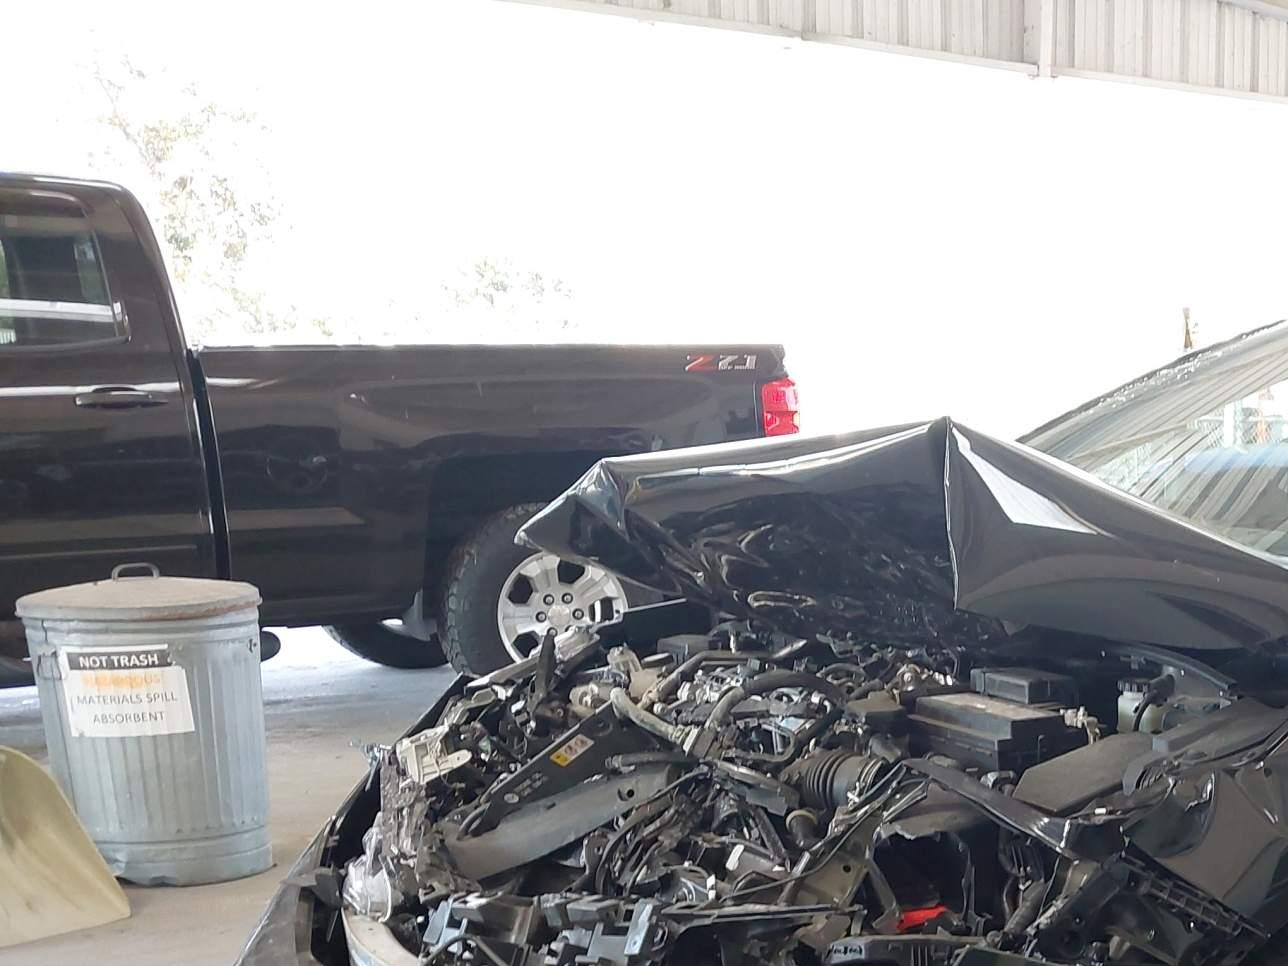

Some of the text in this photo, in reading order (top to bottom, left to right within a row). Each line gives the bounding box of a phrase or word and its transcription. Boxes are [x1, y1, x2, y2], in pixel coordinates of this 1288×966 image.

[79, 653, 159, 668] NOT TRASH
[77, 691, 178, 705] MATERIALS SPILL
[93, 711, 165, 724] ABSORBENT
